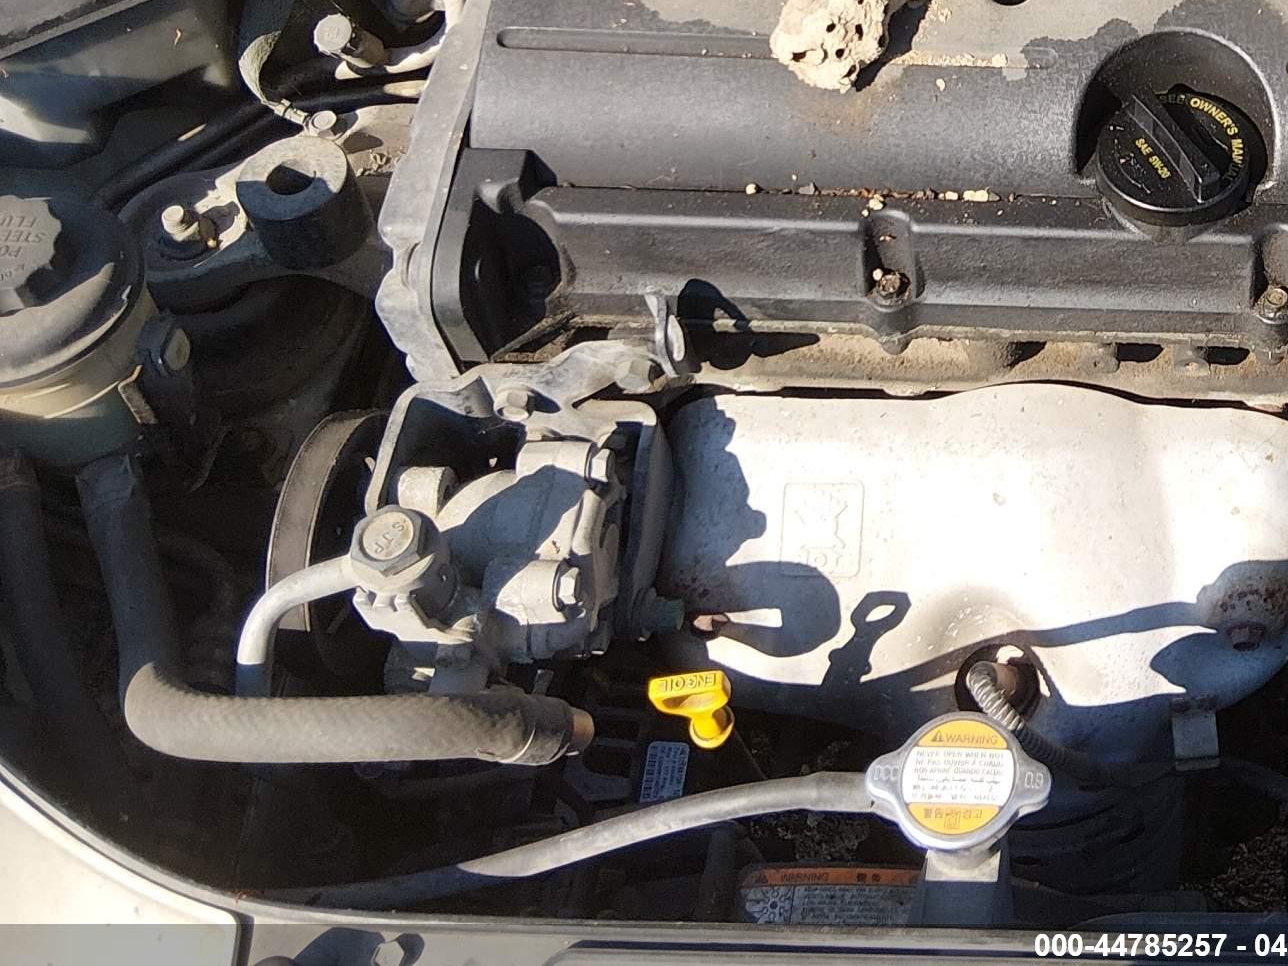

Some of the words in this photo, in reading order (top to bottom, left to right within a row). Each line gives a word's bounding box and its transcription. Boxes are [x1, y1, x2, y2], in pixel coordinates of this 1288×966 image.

[1190, 97, 1240, 136] OWNER'S
[1134, 137, 1154, 156] SAE
[1147, 154, 1172, 179] 5W-20
[658, 676, 686, 693] OIL
[687, 673, 717, 689] ENG
[945, 733, 999, 746] WARNING
[1024, 771, 1045, 790] 0.9
[780, 872, 830, 883] WARNING
